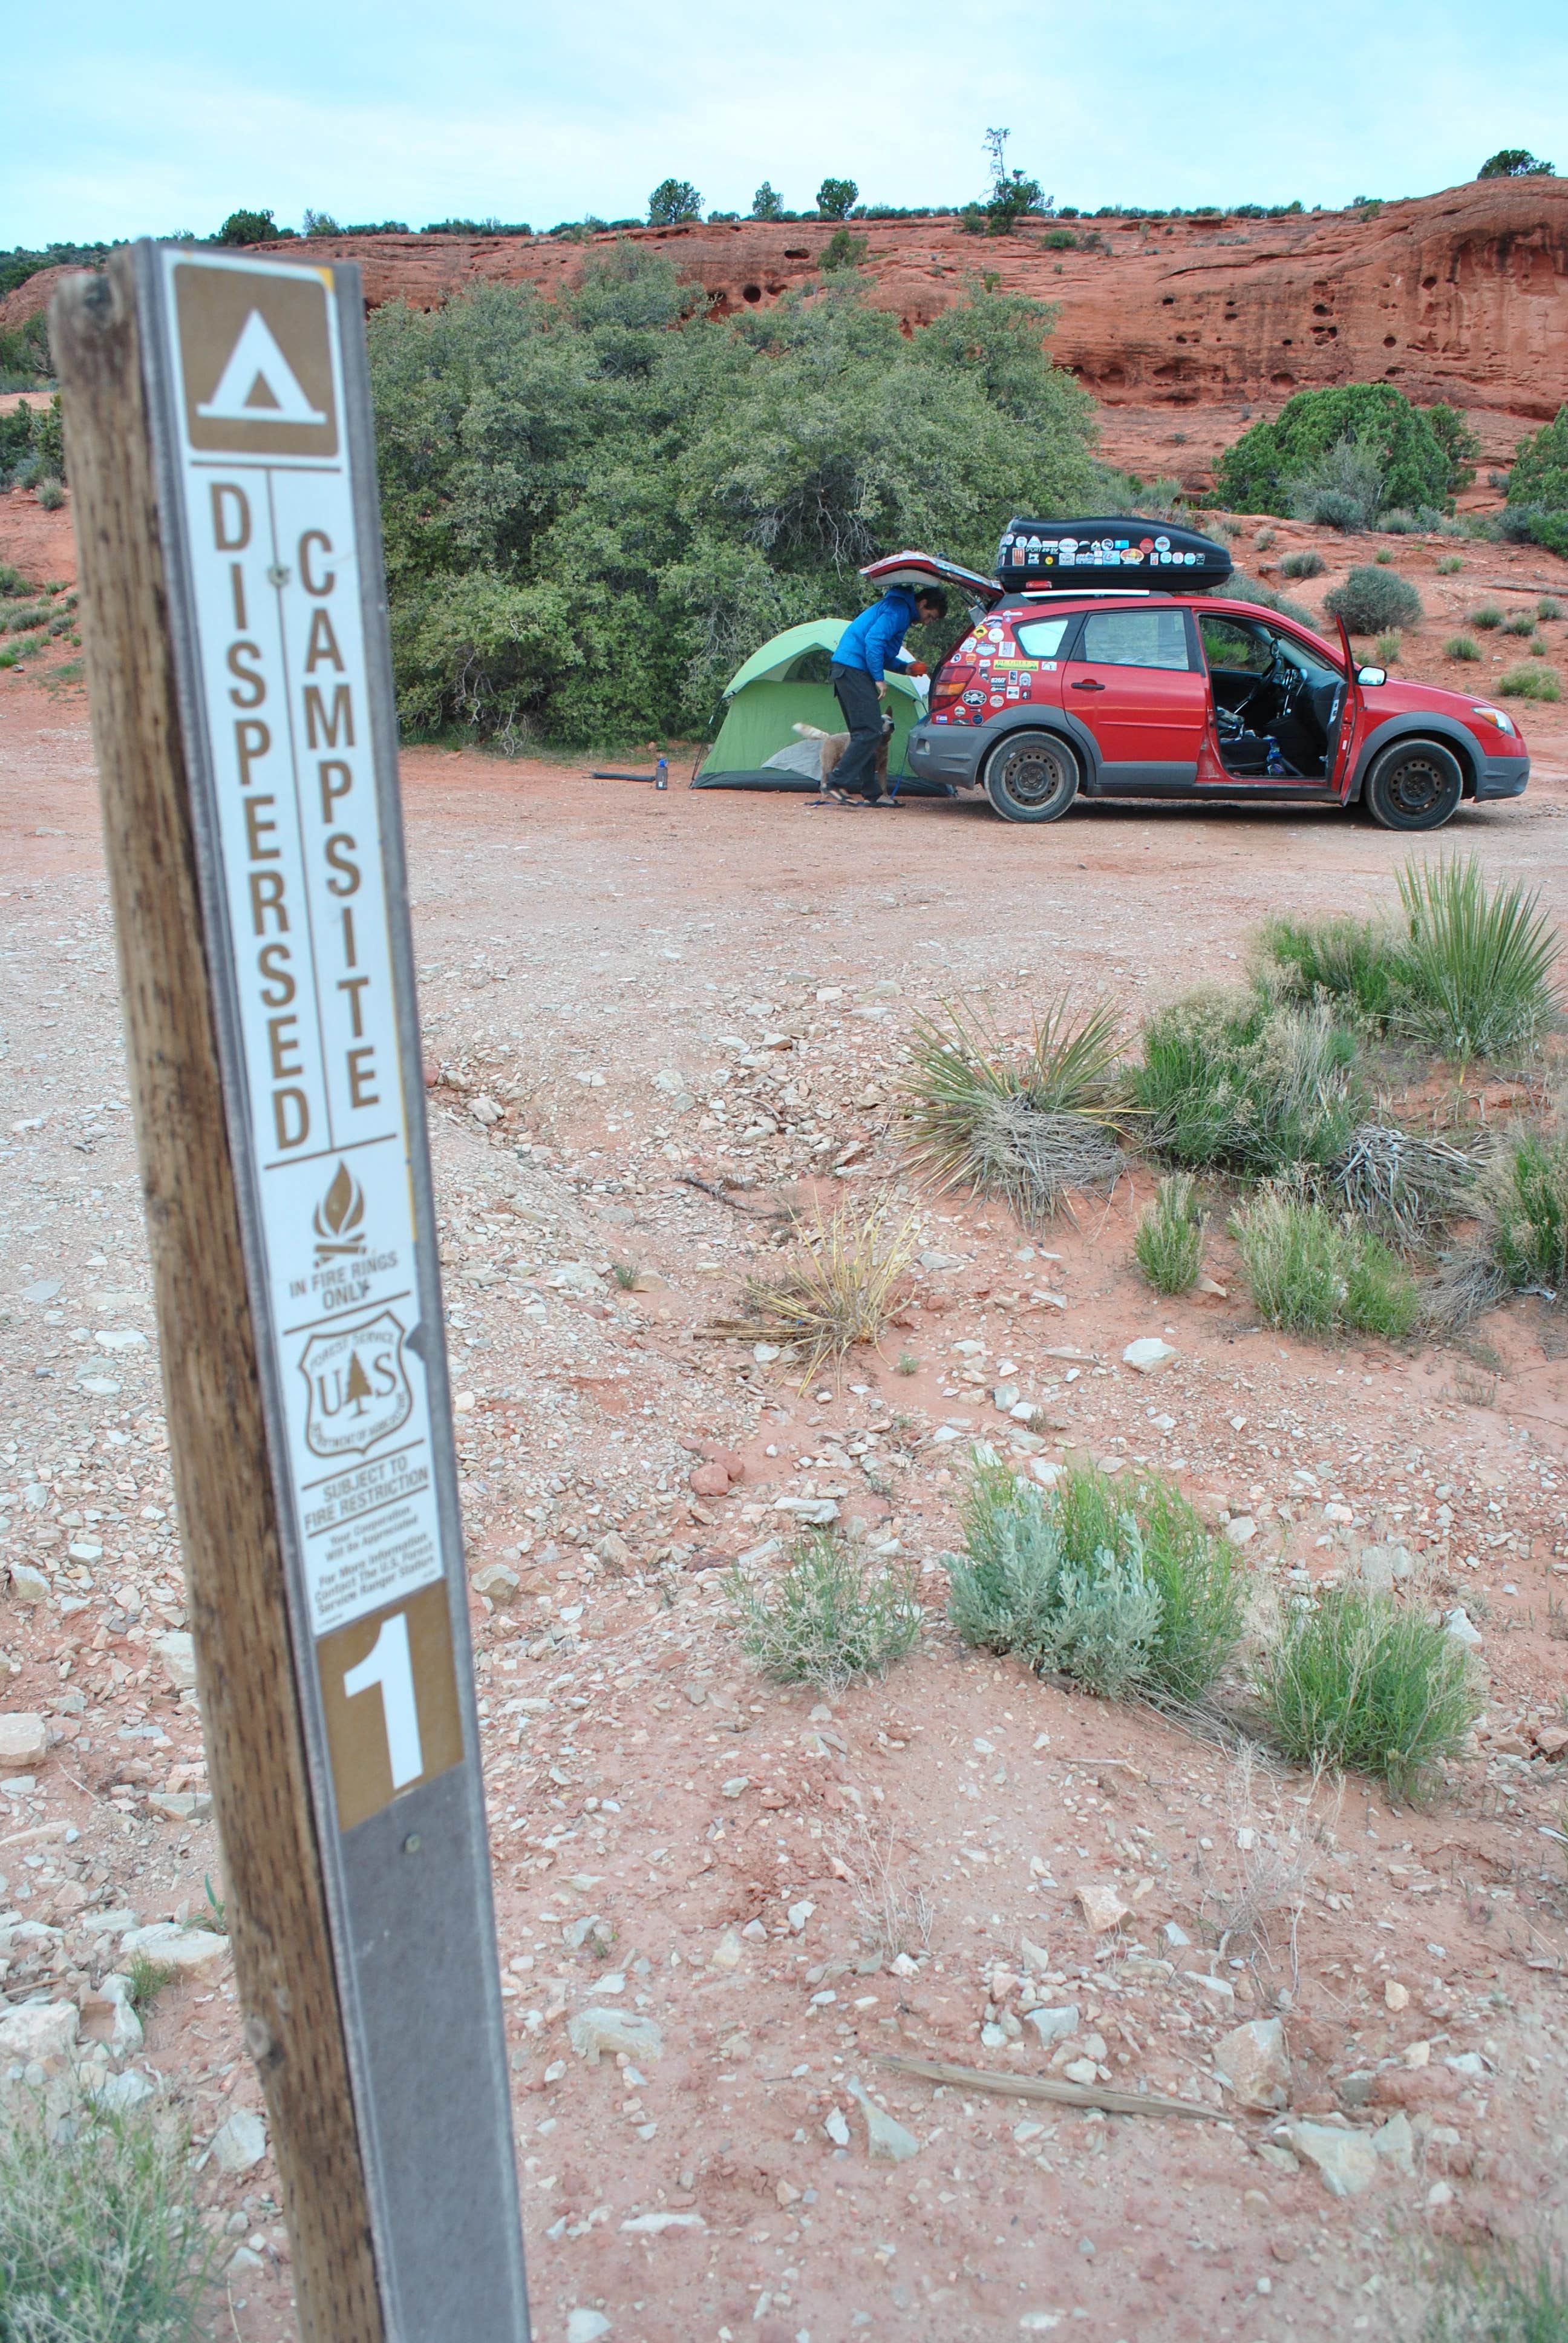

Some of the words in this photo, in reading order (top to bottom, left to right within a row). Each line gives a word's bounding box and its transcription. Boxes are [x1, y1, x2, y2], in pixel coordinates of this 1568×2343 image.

[209, 482, 310, 1150] DISPERSED
[298, 529, 379, 1109] CAMPSITE
[290, 1280, 306, 1298] IN
[312, 1266, 346, 1291] FIRE
[351, 1251, 397, 1279] RINGS
[323, 1279, 368, 1309] ONLY
[309, 1339, 350, 1369] FOREST
[352, 1331, 394, 1345] SERVICE
[304, 1504, 335, 1530] FIRE
[339, 1466, 429, 1515] RESTRICTION
[323, 1463, 385, 1502] SUBJECT
[390, 1455, 408, 1475] TO
[325, 1547, 344, 1563] Will
[362, 1514, 418, 1545] Appreciated
[330, 1532, 350, 1545] Your
[353, 1506, 410, 1536] Cooperation
[315, 1576, 357, 1603] Contact
[360, 1568, 377, 1582] The
[402, 1541, 433, 1562] Forest
[318, 1574, 336, 1588] For
[339, 1560, 365, 1578] More
[368, 1532, 427, 1565] Information
[318, 1591, 358, 1616] Service
[360, 1573, 397, 1596] Ranger
[399, 1555, 434, 1578] Station
[344, 1611, 423, 1790] 1
